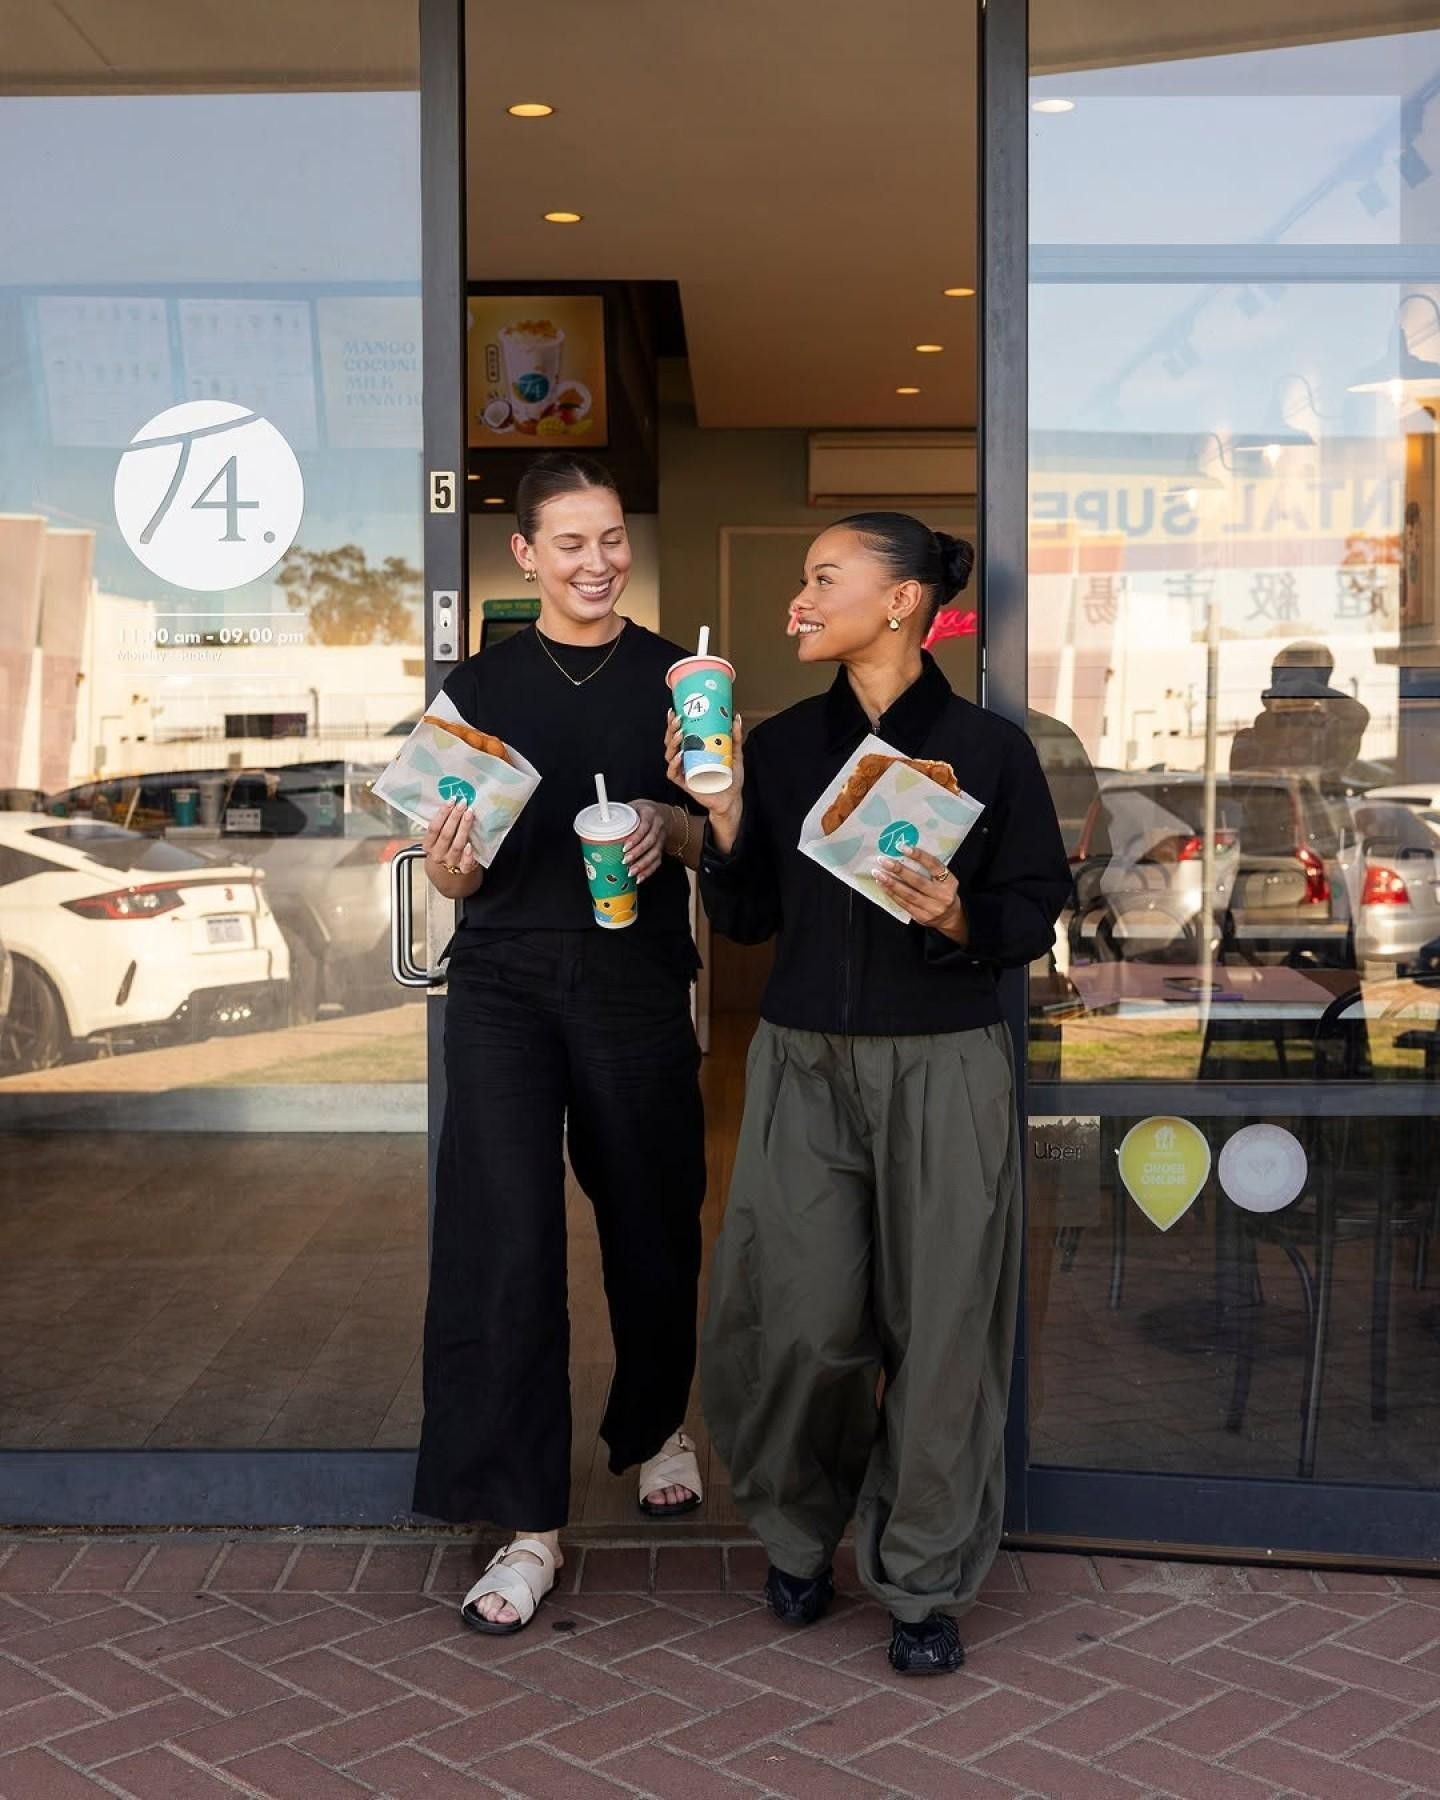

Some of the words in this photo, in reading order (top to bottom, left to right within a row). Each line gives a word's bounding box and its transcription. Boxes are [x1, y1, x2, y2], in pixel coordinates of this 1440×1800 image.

[343, 341, 416, 355] MANGO
[434, 476, 452, 509] 5
[174, 634, 201, 643] am
[219, 628, 273, 643] 09.00
[278, 634, 304, 646] pm
[1035, 1141, 1081, 1159] Uber
